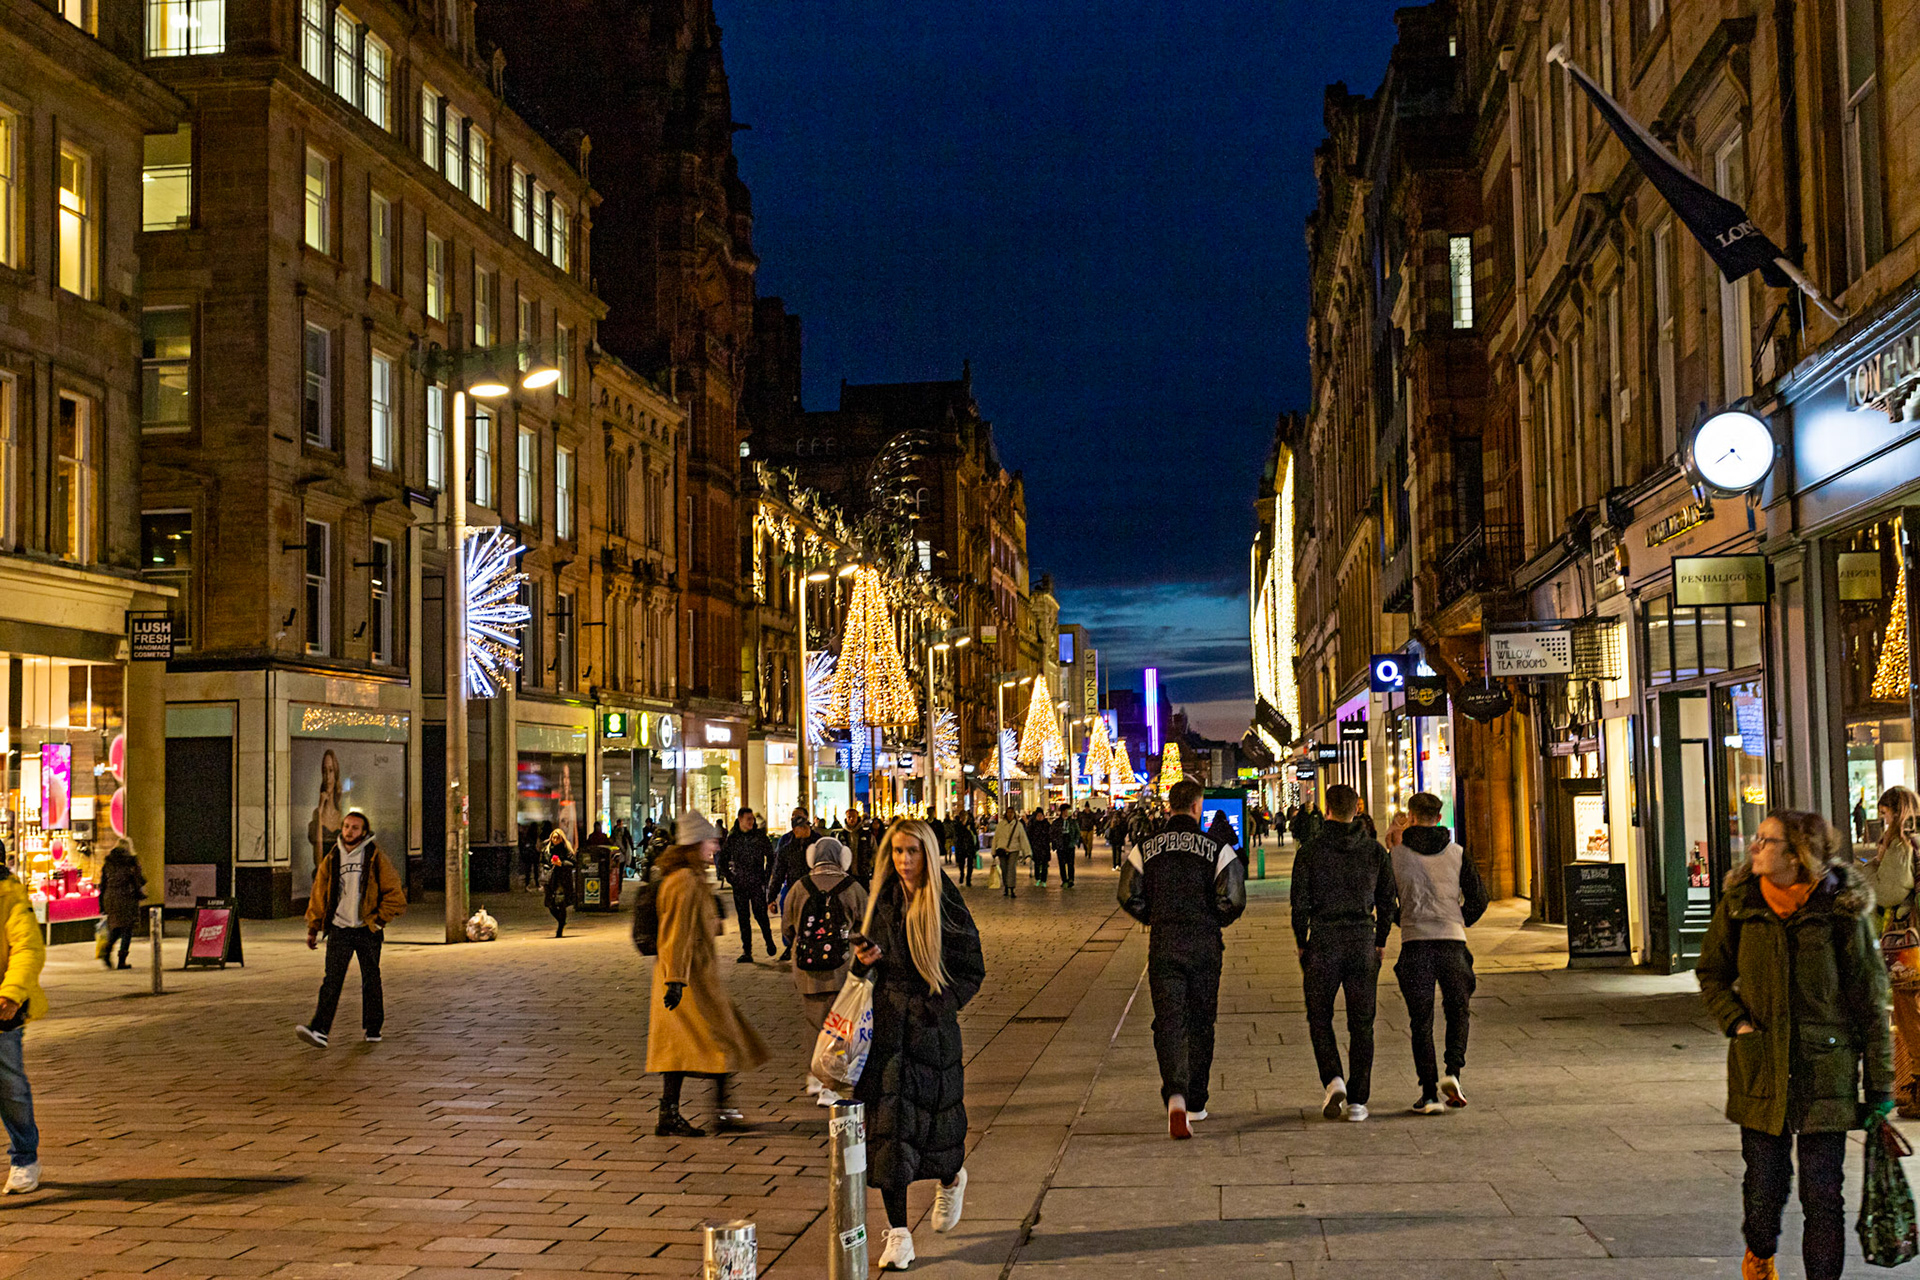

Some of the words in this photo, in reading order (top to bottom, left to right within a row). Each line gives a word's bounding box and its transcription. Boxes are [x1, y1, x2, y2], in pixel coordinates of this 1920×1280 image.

[1681, 573, 1762, 584] PENHALIGON'S
[134, 622, 171, 633] LUSH
[134, 633, 171, 644] FRESH
[1496, 640, 1509, 650] THE
[1086, 652, 1095, 666] ST
[1496, 648, 1532, 660] WILLOW
[1497, 660, 1514, 671] TEA
[1516, 658, 1547, 669] ROOMS
[1086, 670, 1096, 715] ENOCH
